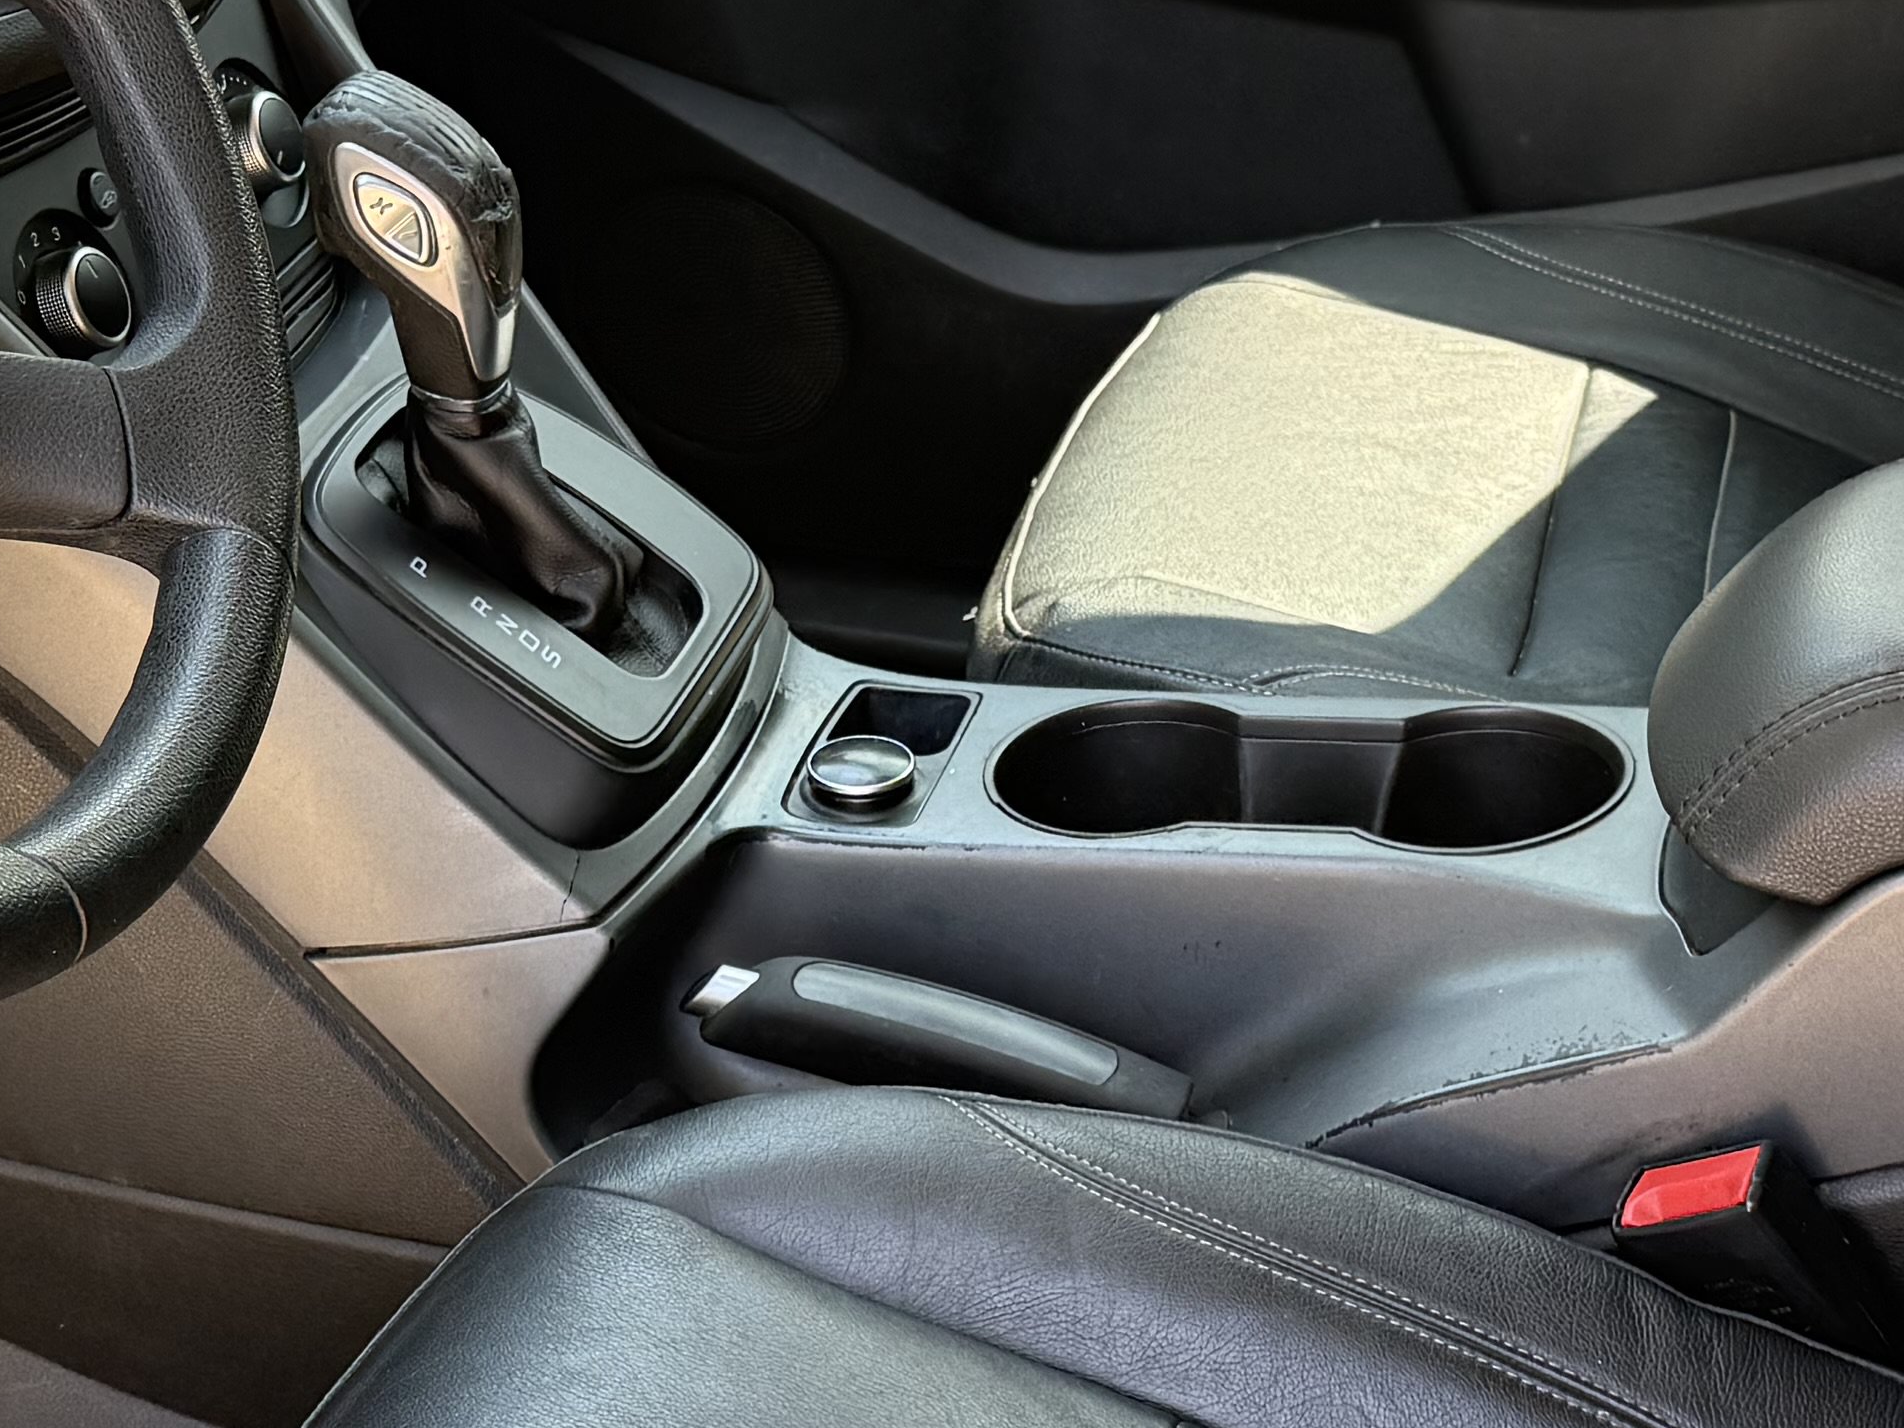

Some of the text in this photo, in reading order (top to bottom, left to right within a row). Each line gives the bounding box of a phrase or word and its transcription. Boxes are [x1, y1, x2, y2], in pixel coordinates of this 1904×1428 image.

[30, 232, 40, 247] 2
[409, 556, 428, 579] P
[469, 595, 493, 618] R
[495, 613, 519, 636] N
[518, 629, 541, 653] D
[540, 644, 562, 669] S
